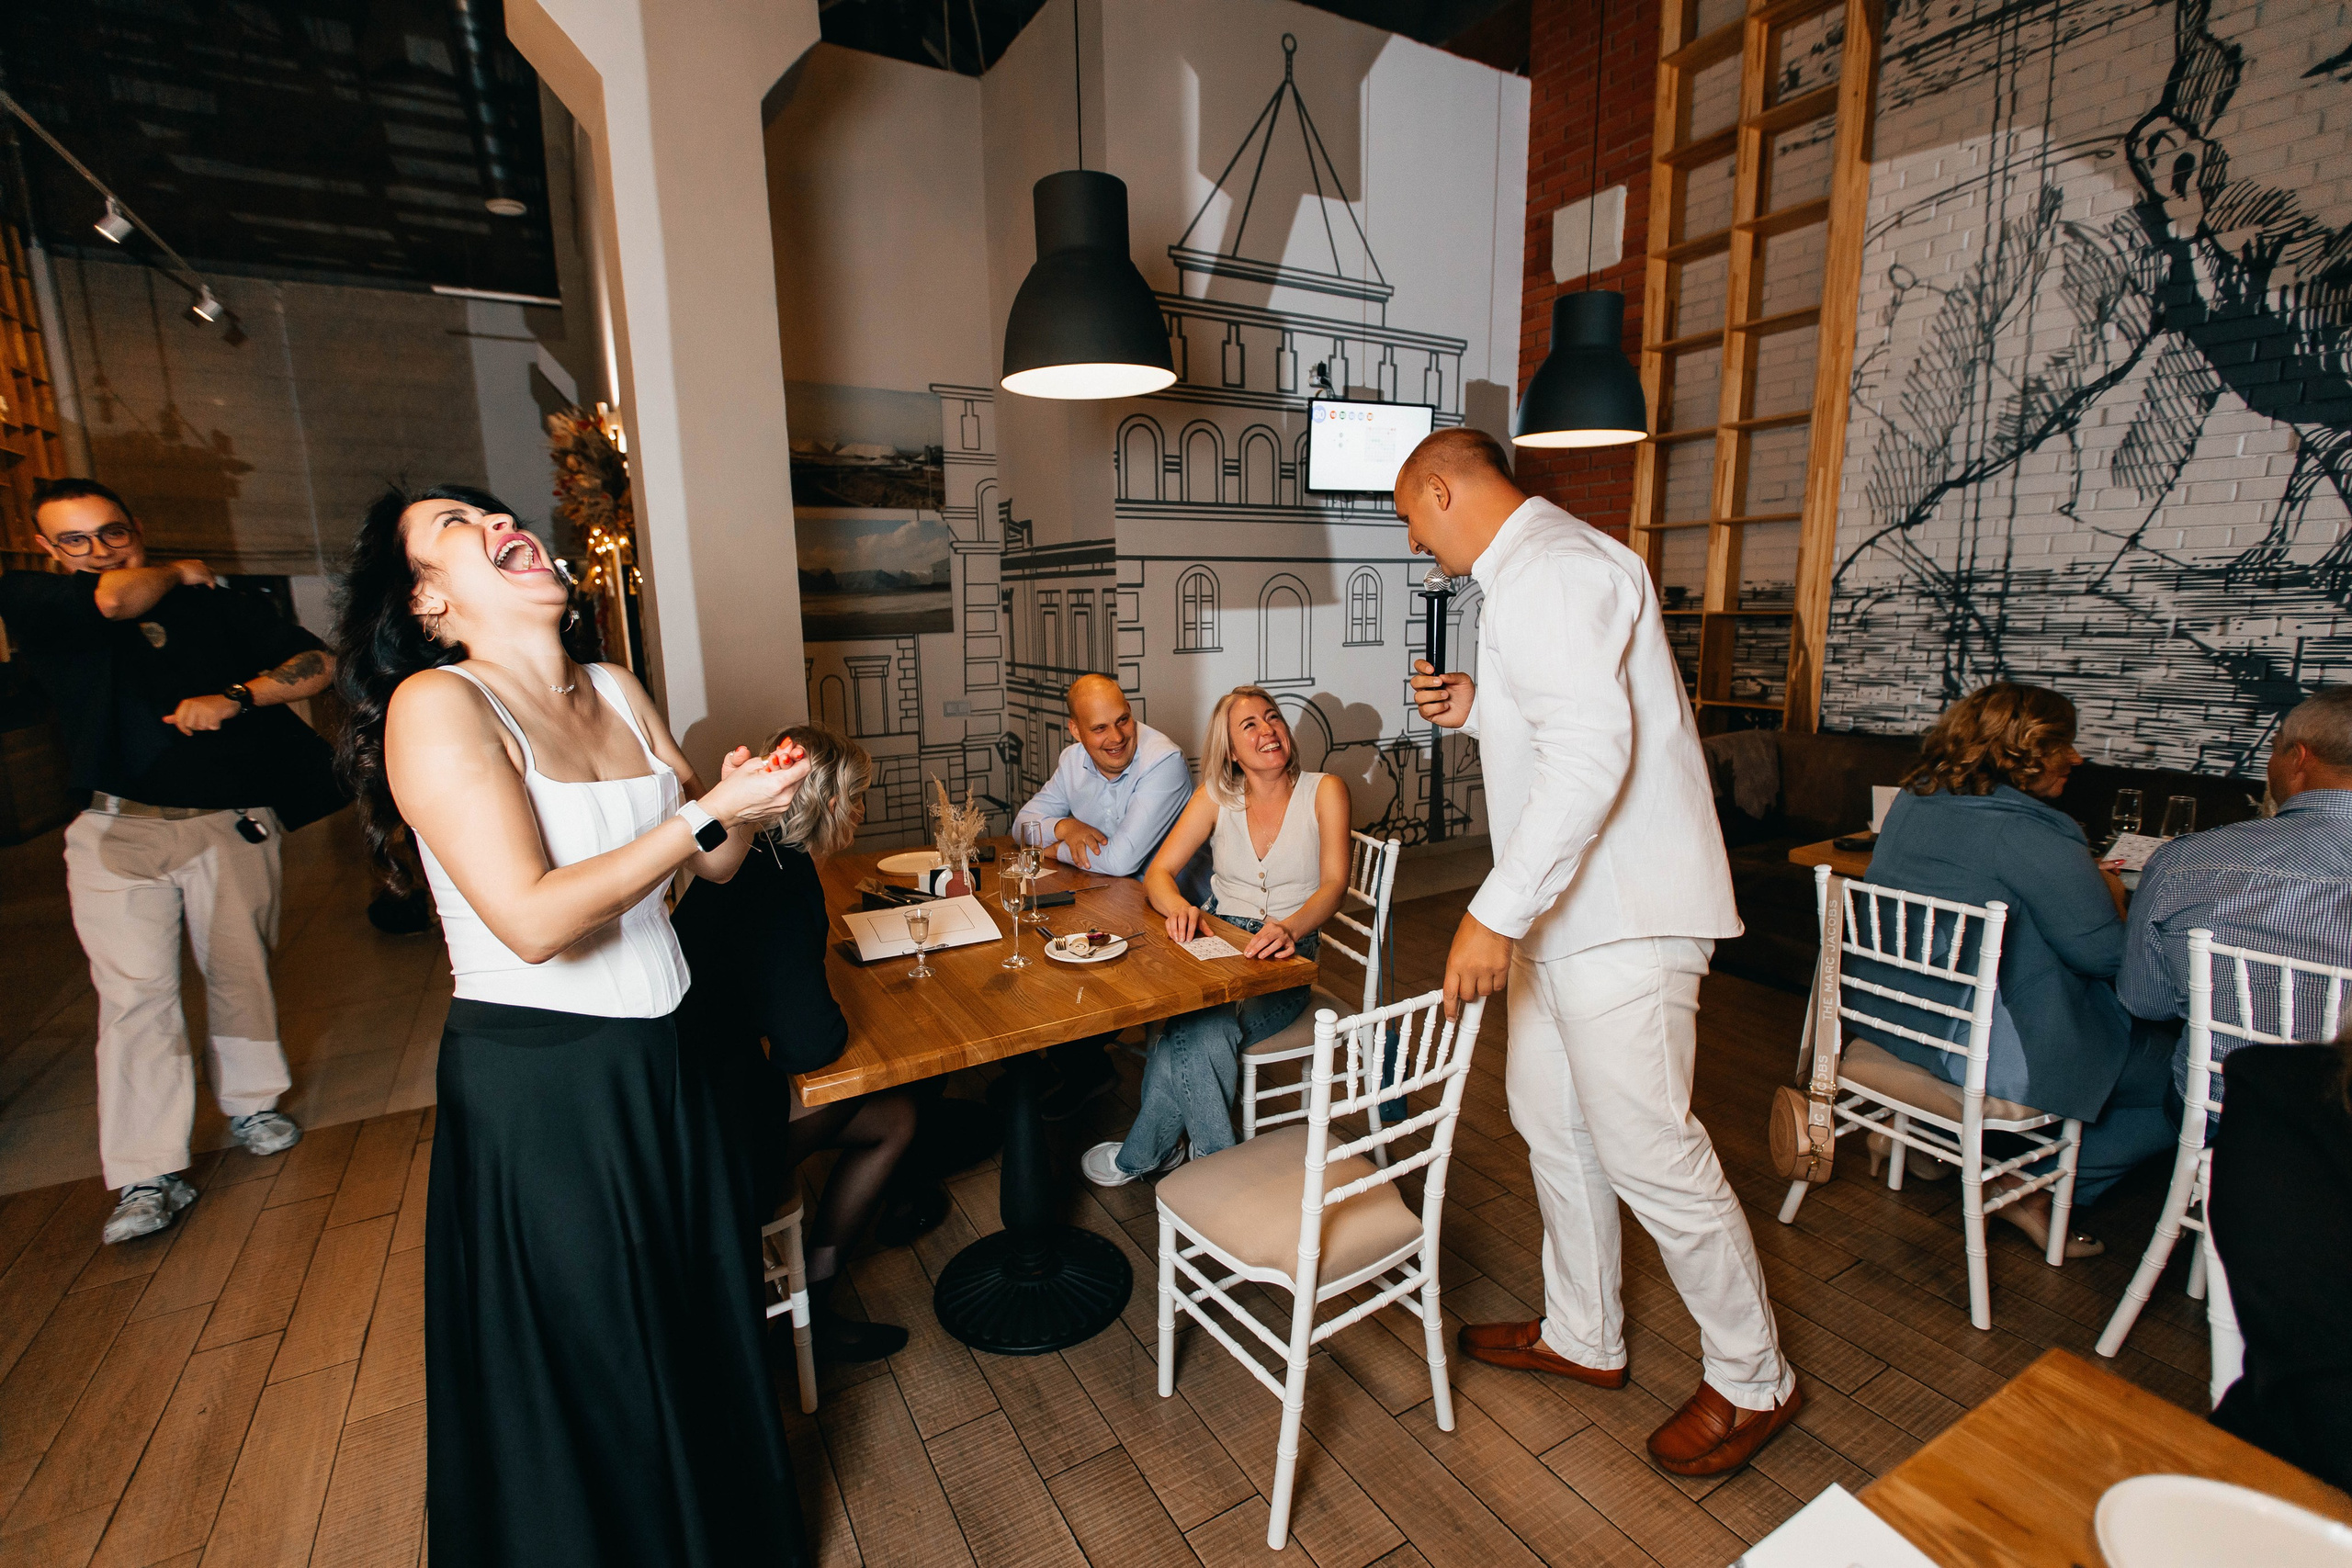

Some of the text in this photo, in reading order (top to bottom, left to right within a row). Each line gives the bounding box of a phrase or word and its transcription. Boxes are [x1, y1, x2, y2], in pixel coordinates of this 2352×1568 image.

[1823, 900, 1838, 1021] THE MARC JACOBS
